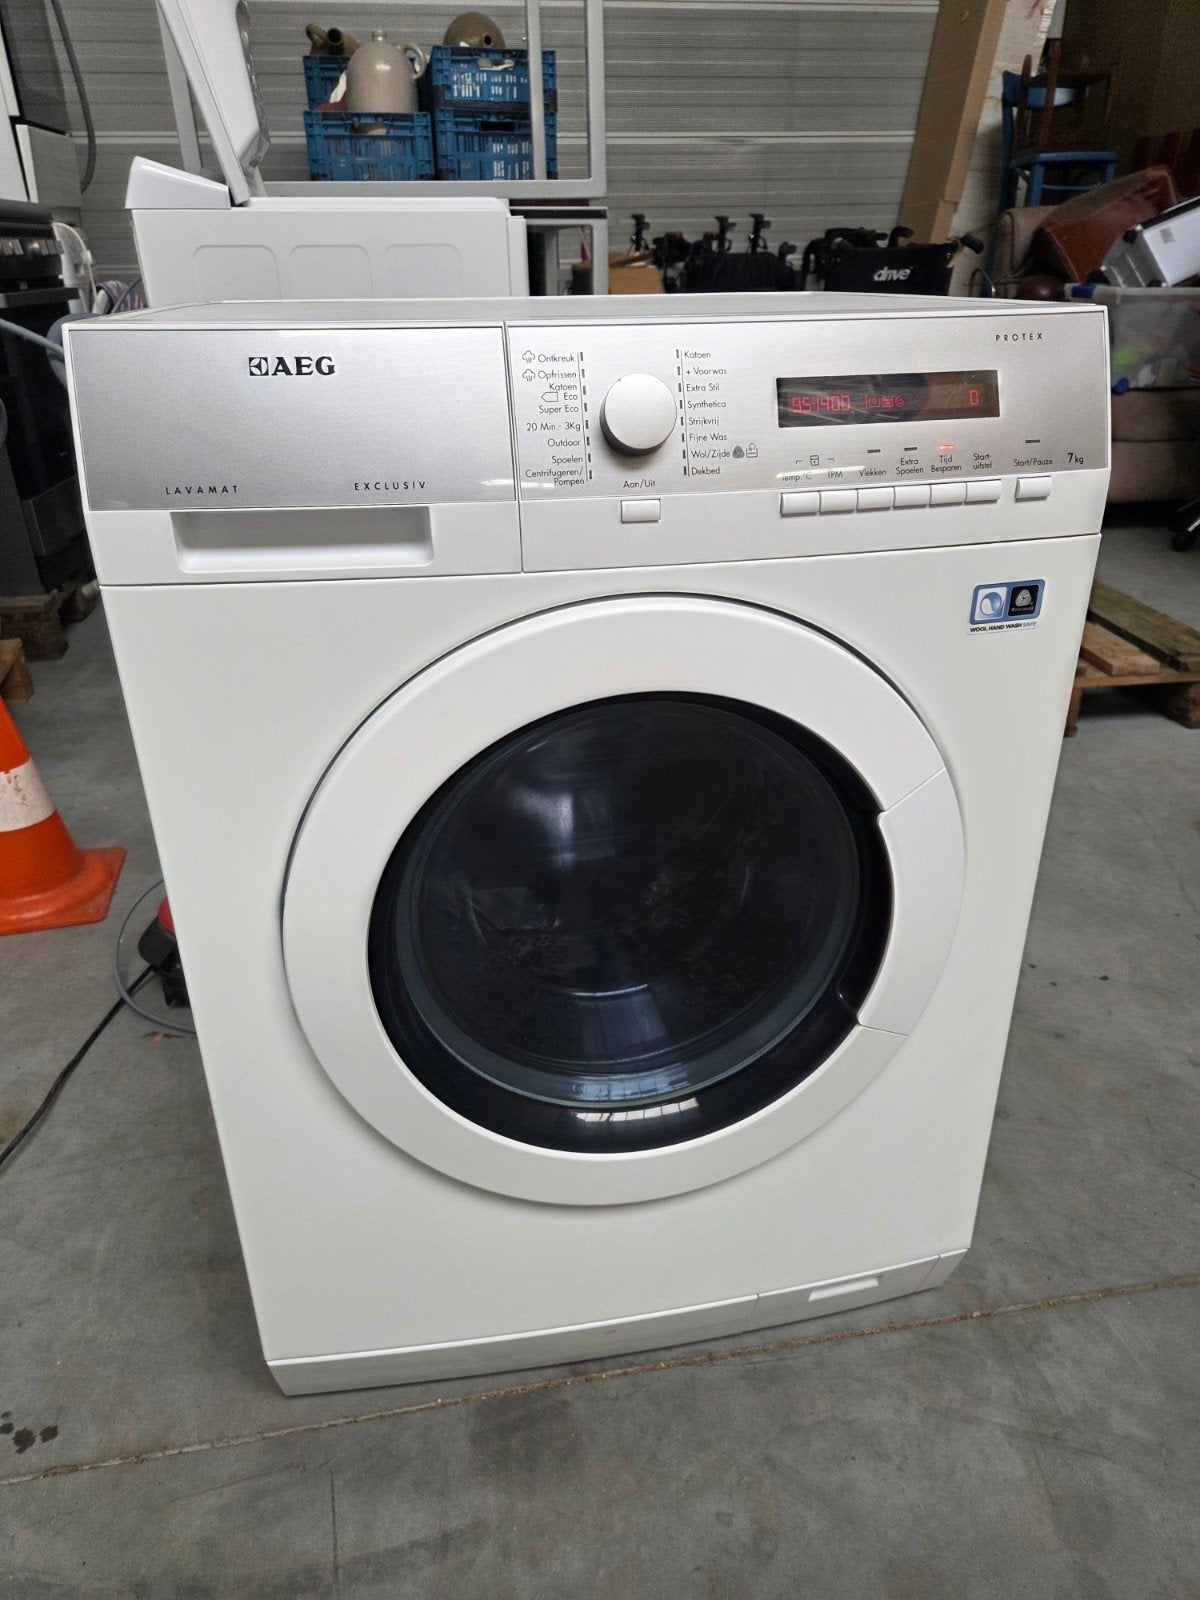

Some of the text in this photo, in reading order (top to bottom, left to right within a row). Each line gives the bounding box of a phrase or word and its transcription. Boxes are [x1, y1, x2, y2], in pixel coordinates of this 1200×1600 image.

[873, 266, 911, 281] drive
[995, 333, 1043, 341] PROTEX
[538, 353, 575, 363] Ontkreuk
[684, 351, 711, 359] Katoen
[271, 356, 336, 376] AEG
[538, 370, 577, 381] Opfrissen
[693, 367, 727, 376] Voorwas
[686, 383, 720, 392] Extra Stil
[539, 405, 579, 415] Super Eco
[687, 400, 727, 410] Synthetica
[527, 423, 538, 431] 20
[565, 422, 581, 431] 3Kg
[689, 417, 720, 427] Strijkvrij
[689, 432, 728, 442] Fijne Was
[547, 438, 581, 447] Outdoor
[691, 449, 731, 460] Wol/Zijde
[939, 455, 953, 464] Tijd
[974, 453, 992, 461] Start-
[551, 455, 584, 465] Spoelen
[900, 458, 919, 466] Extra
[1013, 457, 1053, 467] Start/Pauze
[691, 466, 721, 475] Dekbed
[895, 466, 924, 476] Spoelen
[931, 464, 962, 474] Besparen
[973, 462, 992, 470] uitstel
[859, 469, 887, 477] Vlekken
[354, 481, 426, 491] EXCLUSIV
[554, 478, 585, 487] Pompen
[623, 479, 656, 489] Aan/Uit
[165, 485, 238, 495] LAVAMAT
